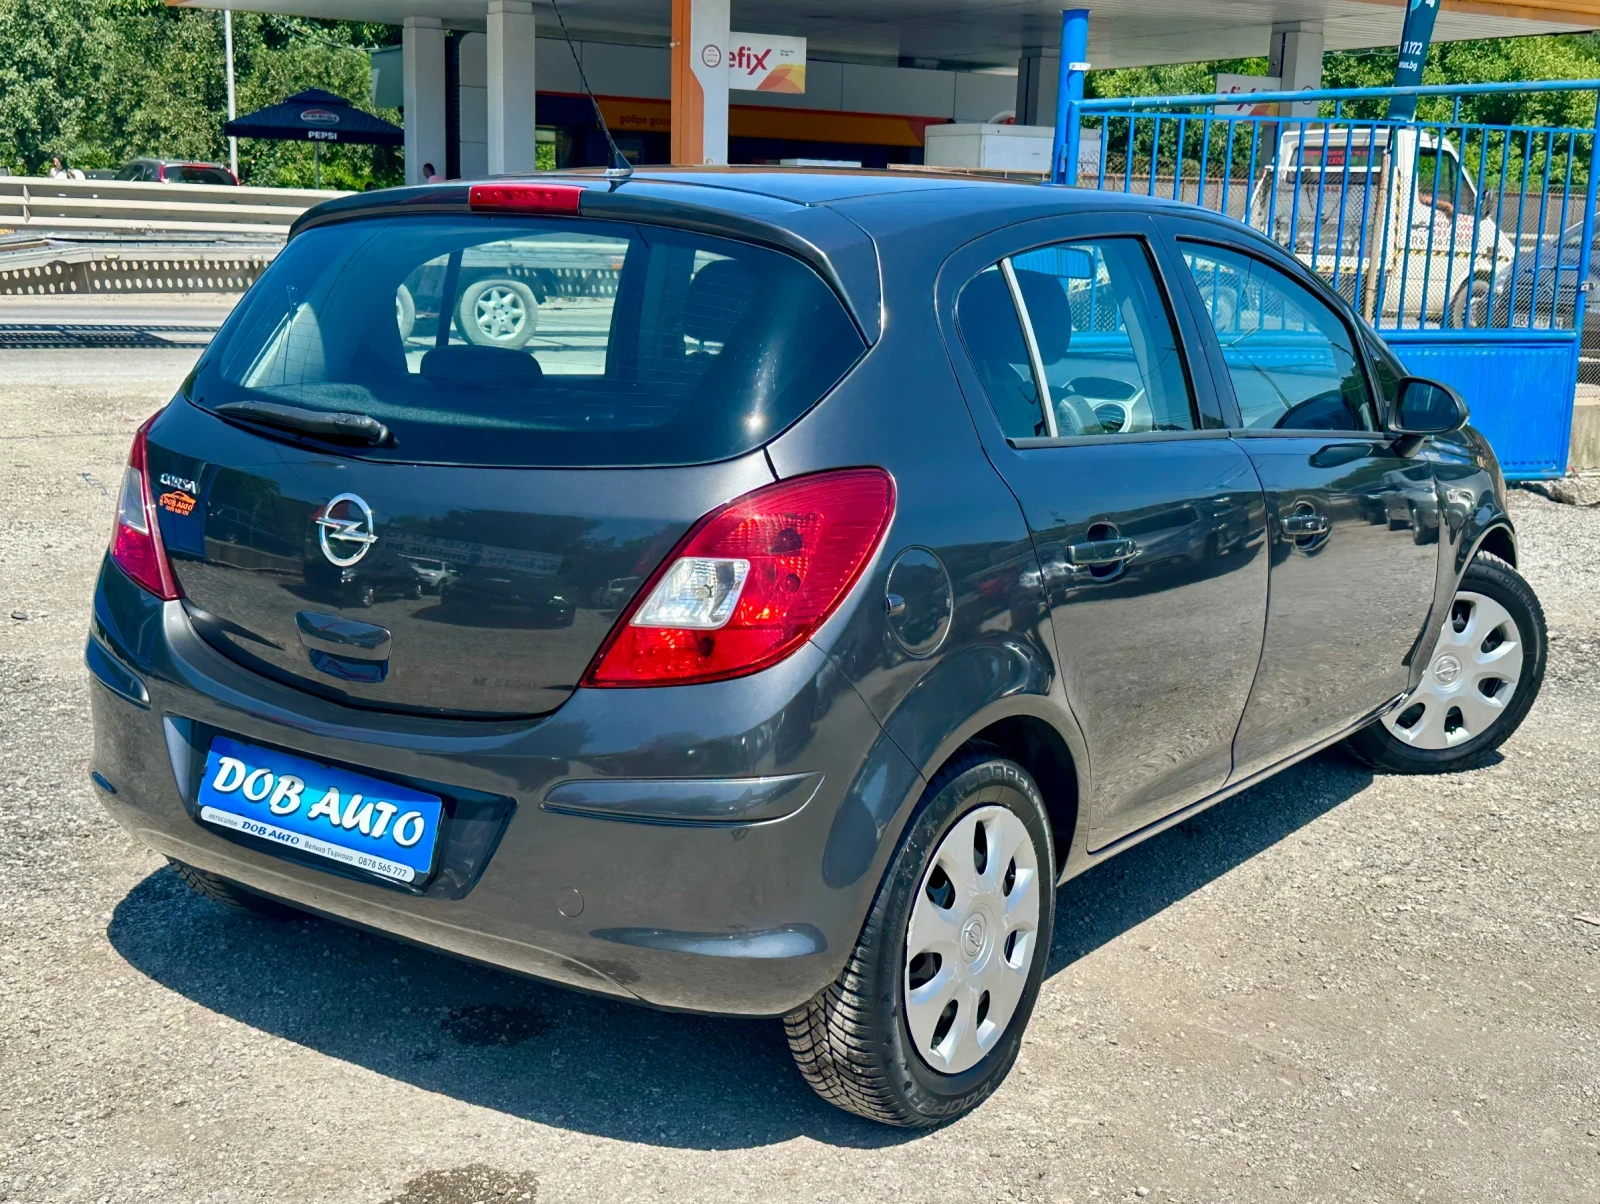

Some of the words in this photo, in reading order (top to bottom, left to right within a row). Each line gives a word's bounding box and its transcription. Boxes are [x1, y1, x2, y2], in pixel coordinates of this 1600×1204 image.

[729, 46, 772, 75] efix
[308, 131, 338, 140] PEPSI
[212, 756, 305, 815] DOB
[307, 786, 425, 846] AUTO
[241, 821, 267, 836] DOB
[268, 830, 300, 845] AUTO
[358, 856, 377, 869] 0878
[378, 862, 392, 874] 565
[393, 867, 407, 878] 777
